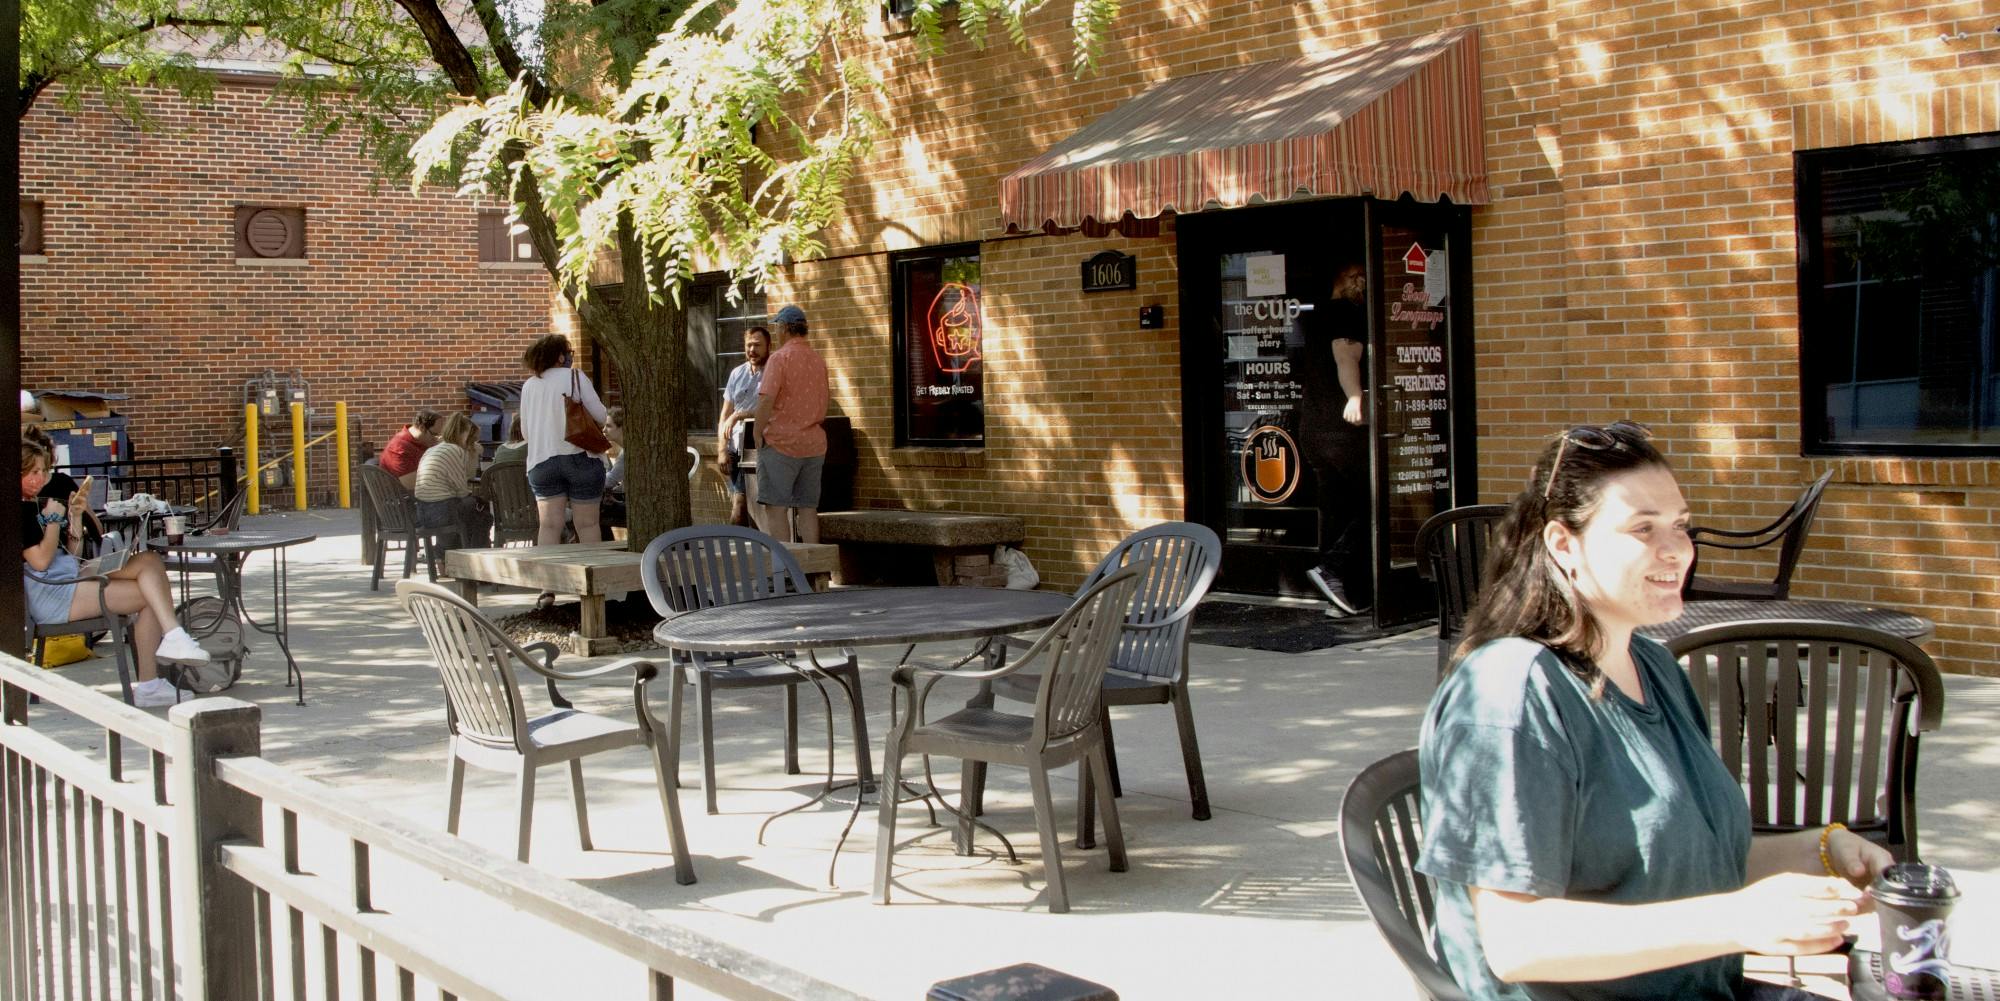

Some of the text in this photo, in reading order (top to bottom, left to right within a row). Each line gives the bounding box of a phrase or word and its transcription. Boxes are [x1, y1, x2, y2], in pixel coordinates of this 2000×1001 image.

[1092, 262, 1122, 286] 1606
[1402, 282, 1431, 310] Body
[1234, 298, 1301, 326] the cup
[1390, 302, 1444, 330] Language
[1241, 324, 1294, 335] coffee house
[1396, 346, 1442, 363] TATTOOS
[1246, 362, 1291, 375] HOURS
[915, 385, 927, 396] GET
[951, 384, 975, 397] ROASTED
[1394, 374, 1446, 392] PIERCINGS
[1411, 416, 1432, 427] HOURS
[1404, 433, 1418, 442] Tues
[1423, 432, 1441, 442] Thurs
